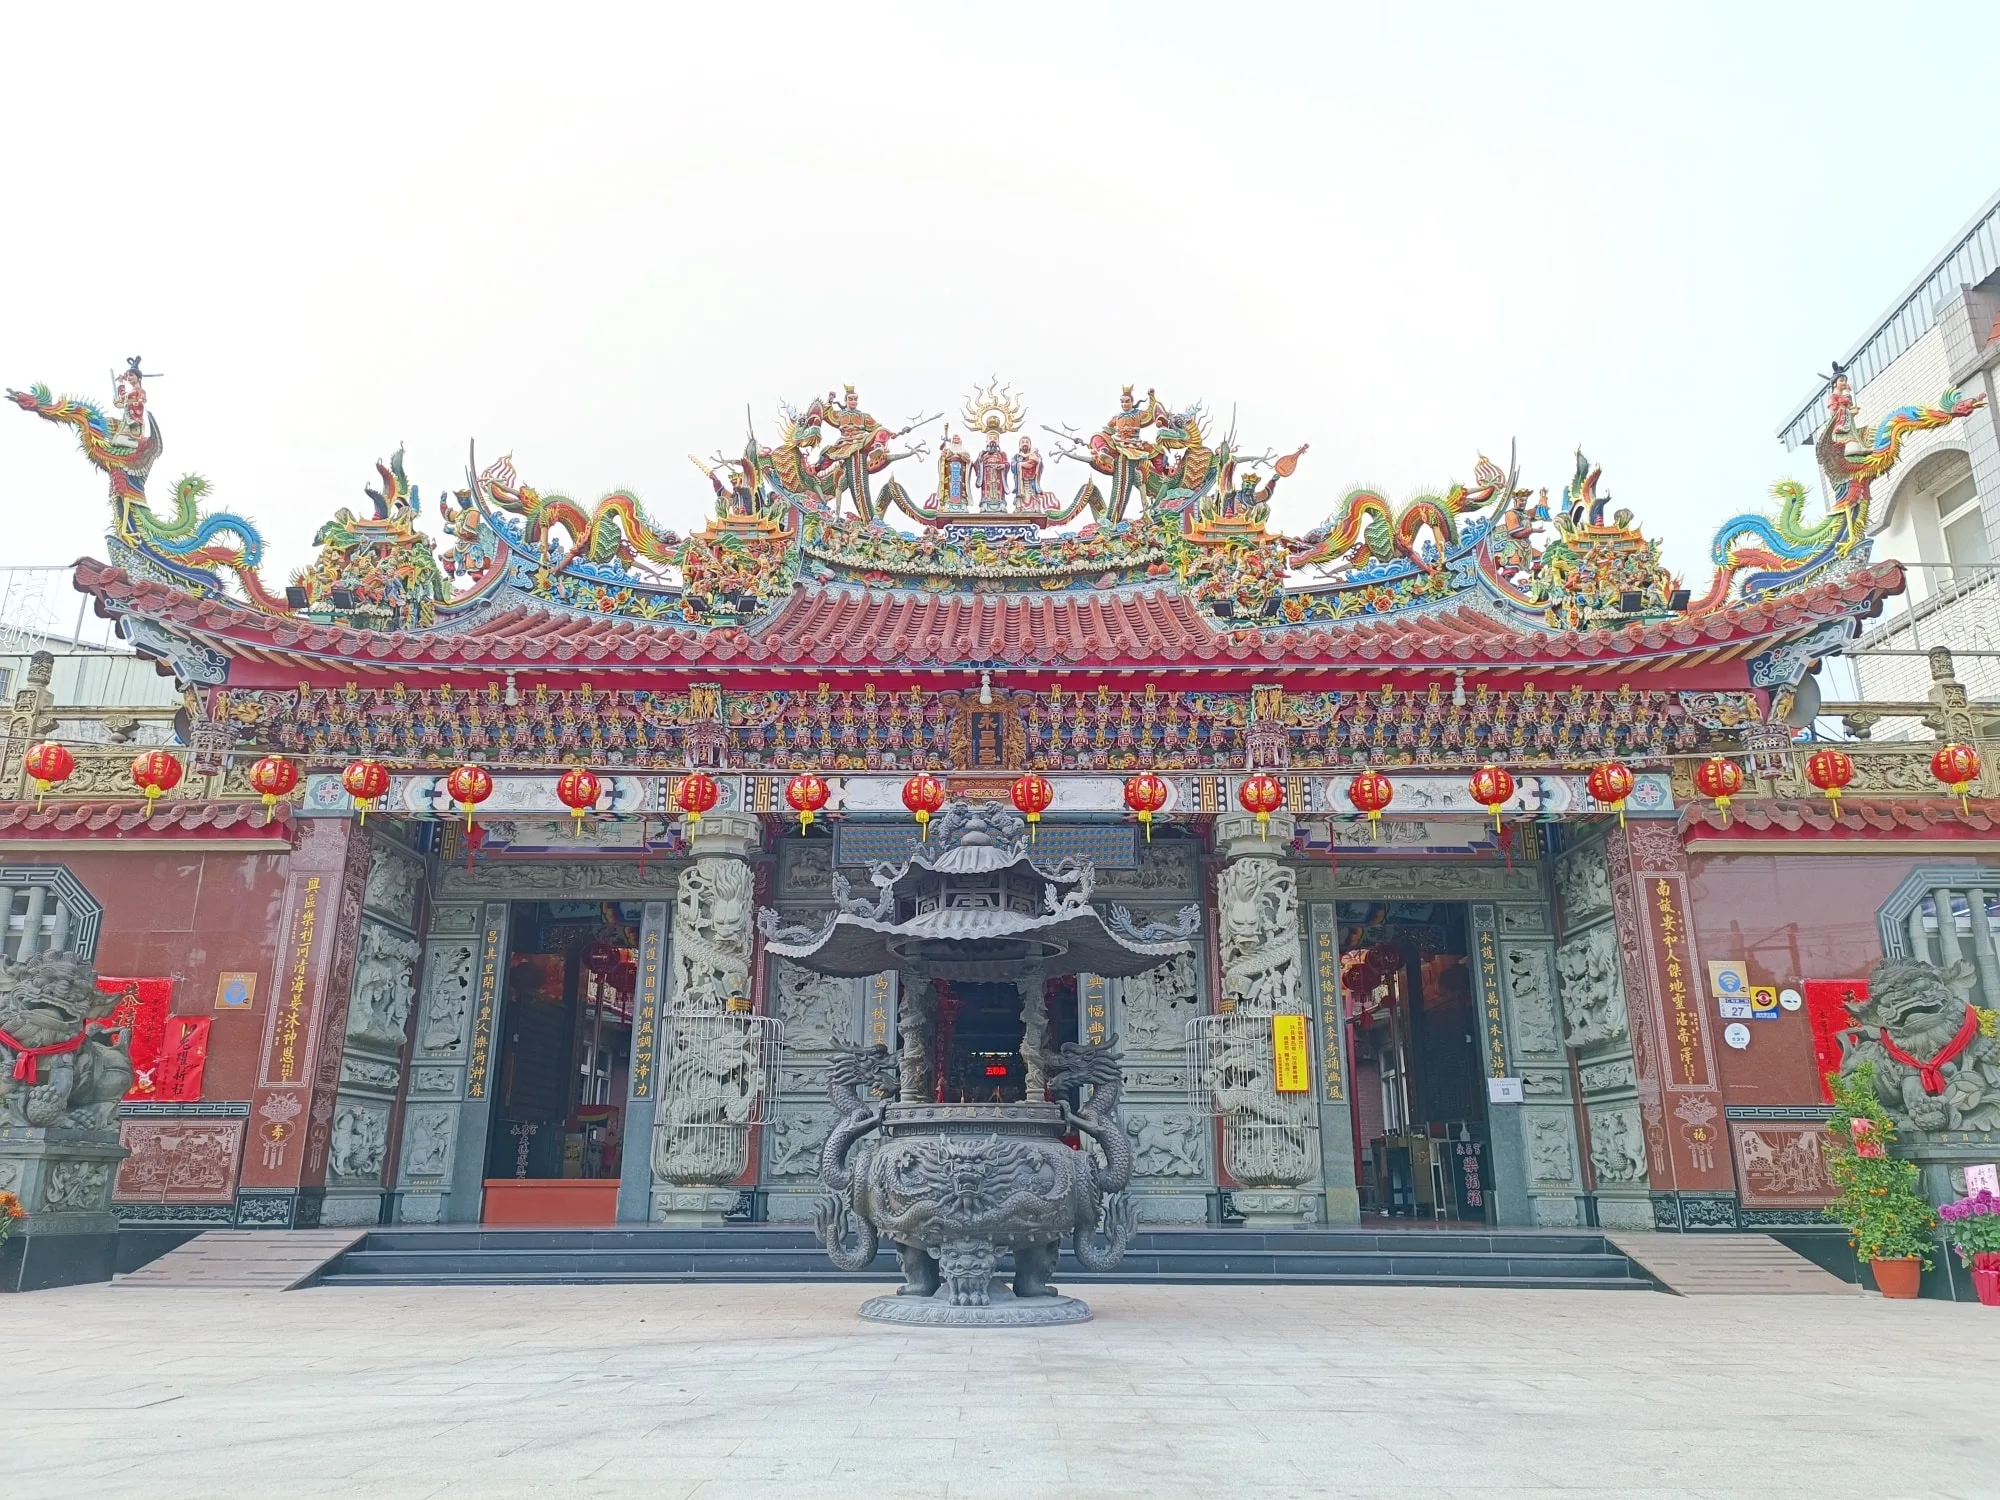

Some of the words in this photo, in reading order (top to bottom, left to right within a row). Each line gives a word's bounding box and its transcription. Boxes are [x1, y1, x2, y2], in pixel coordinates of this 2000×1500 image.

[977, 713, 998, 764] 永昌宮
[1731, 1007, 1745, 1017] 27
[1692, 1127, 1707, 1142] 福
